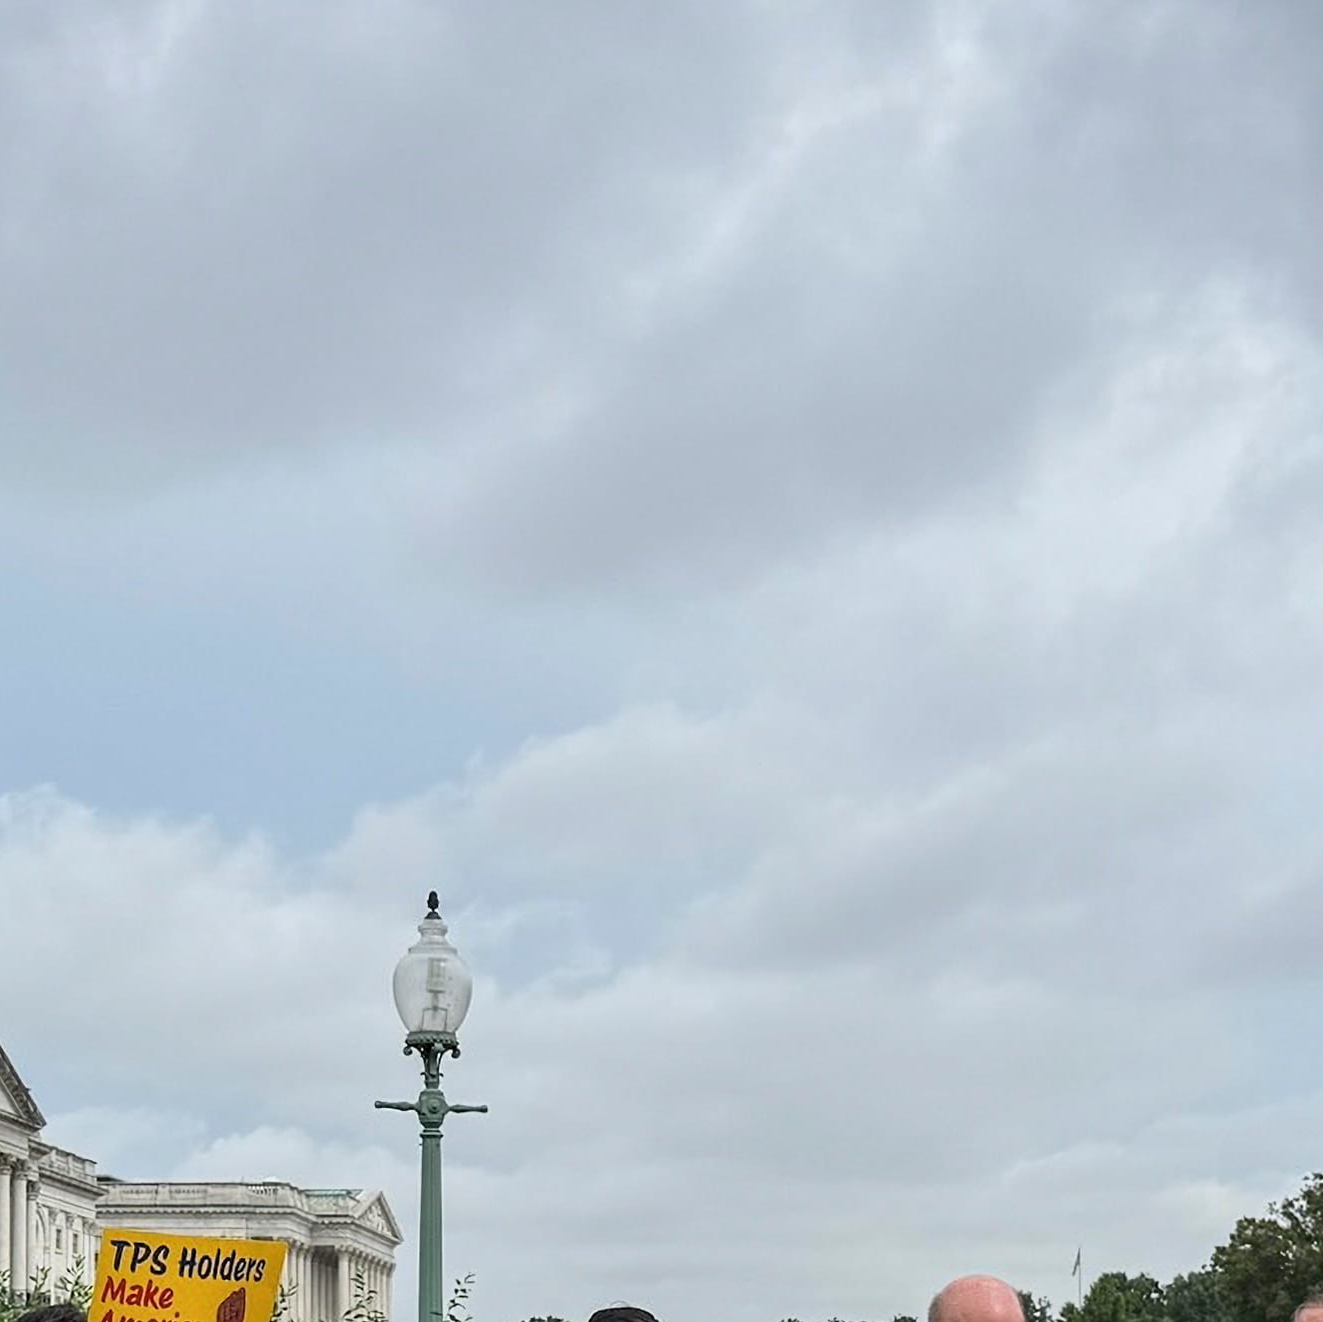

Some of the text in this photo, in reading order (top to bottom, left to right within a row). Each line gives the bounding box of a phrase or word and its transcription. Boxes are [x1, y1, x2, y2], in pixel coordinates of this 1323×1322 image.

[109, 1239, 267, 1283] TPS Holders
[101, 1275, 174, 1310] Make
